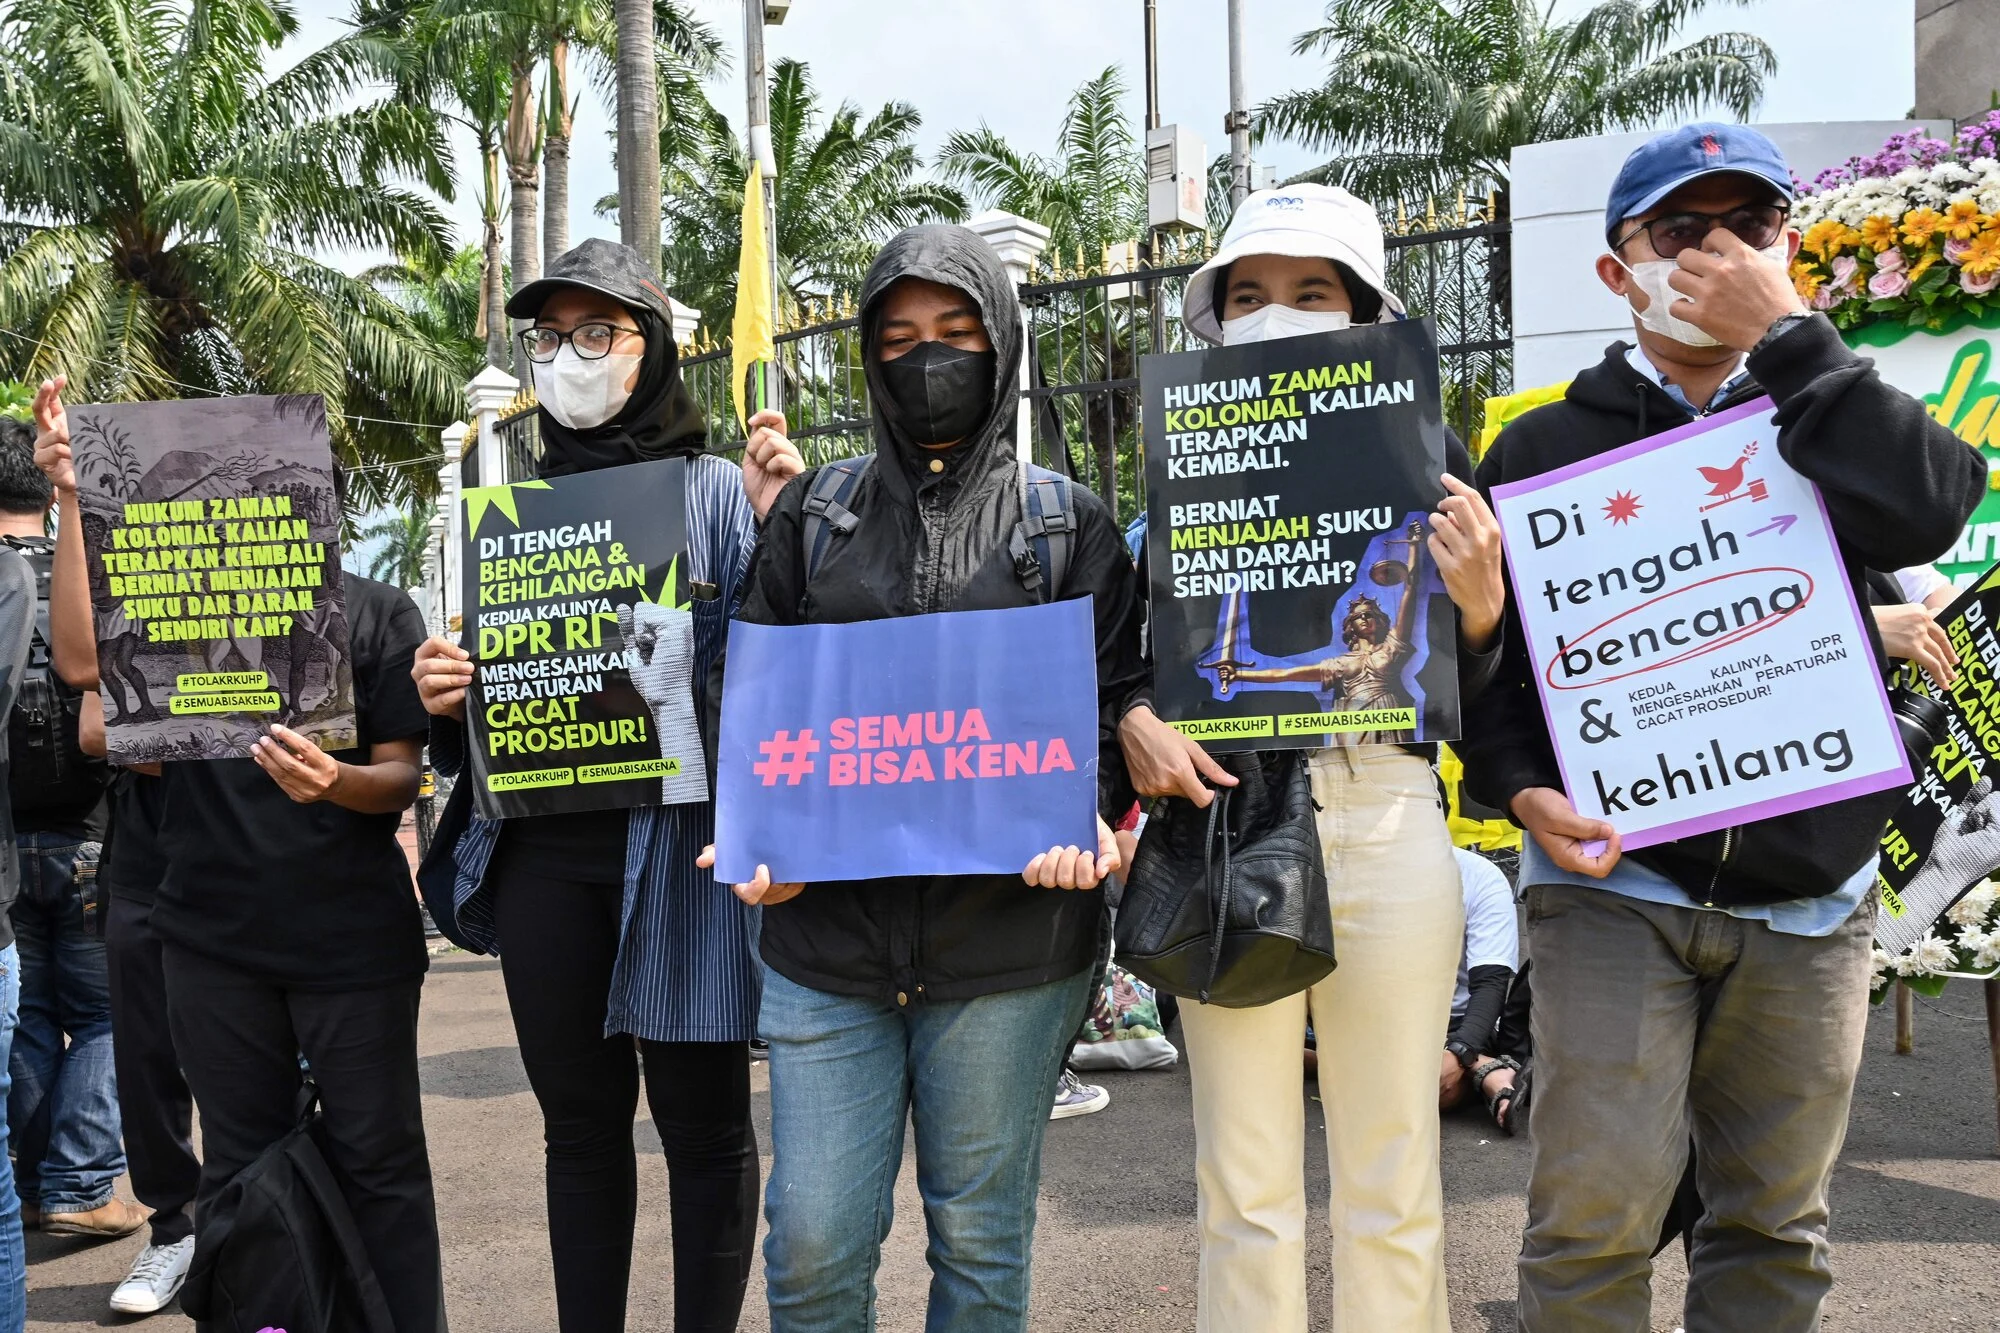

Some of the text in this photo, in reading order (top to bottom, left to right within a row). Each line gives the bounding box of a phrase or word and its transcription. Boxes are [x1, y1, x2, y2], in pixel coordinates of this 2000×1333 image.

[1164, 360, 1373, 408] HUKUM ZAMAN
[1165, 379, 1415, 432] KOLONIAL KALIAN
[1165, 418, 1308, 456] TERAPKAN
[1167, 446, 1290, 480] KEMBALI.
[124, 496, 291, 524] HUKUM ZAMAN
[1170, 494, 1280, 527] BERNIAT
[1170, 506, 1392, 551] MENJAJAH SUKU
[1527, 503, 1586, 550] Di
[112, 520, 308, 549] KOLONIAL KALIAN
[480, 520, 612, 560] DI TENGAH
[102, 542, 324, 574] TERAPKAN KEMBALI
[479, 542, 629, 583] BENCANA &
[1172, 538, 1331, 574] DAN DARAH
[1543, 518, 1740, 613] tengah
[110, 566, 322, 596] BERNIAT MENJAJAH
[479, 564, 646, 606] KEHILANGAN
[1174, 560, 1356, 598] SENDIRI KAH?
[124, 590, 314, 620] SUKU DAN DARAH
[478, 598, 612, 628] KEDUA KALINYA
[1964, 600, 1986, 632] DI
[148, 616, 293, 642] SENDIRI KAH?
[478, 612, 607, 660] DPR RI
[1556, 582, 1806, 678] bencana
[182, 674, 263, 687] #TOLAKRKUHP
[480, 650, 638, 684] MENGESAHKAN
[1628, 634, 1842, 702] KEDUA KALINYA DPR
[1632, 648, 1848, 717] MENGESAHKAN PERATURAN
[175, 695, 275, 708] #SEMUABISAKENA
[484, 674, 602, 704] PERATURAN
[1636, 685, 1772, 730] CACAT PROSEDUR!
[486, 696, 580, 728] CACAT
[1284, 711, 1410, 729] #SEMUABISAKENA
[1578, 698, 1622, 744] &
[489, 716, 648, 756] PROSEDUR!
[754, 708, 992, 786] # SEMUA
[493, 761, 676, 786] #TOLAKRKUHP #SEMUABISAKENA
[828, 738, 1076, 786] BISA KENA
[1593, 727, 1854, 816] kehilang
